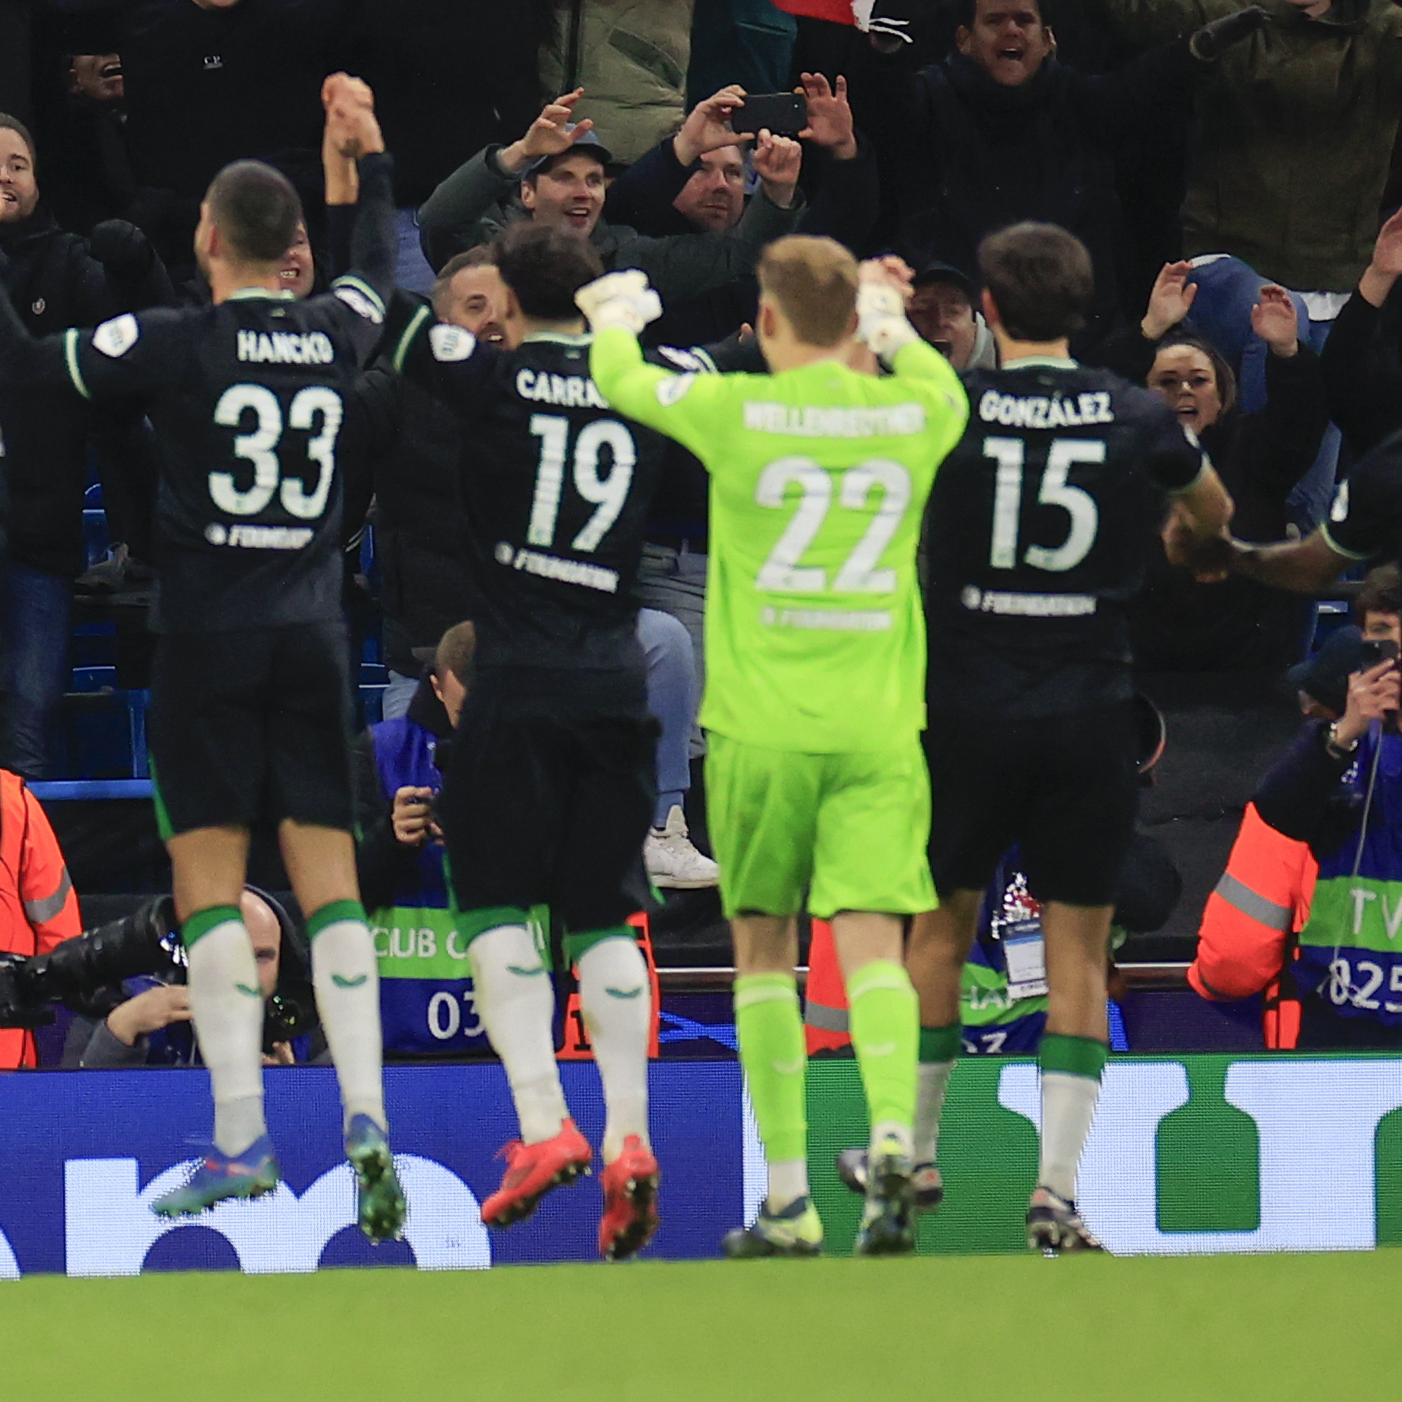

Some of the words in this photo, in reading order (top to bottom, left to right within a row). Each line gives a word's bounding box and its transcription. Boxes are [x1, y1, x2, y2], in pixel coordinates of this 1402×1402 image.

[236, 329, 335, 365] HANCKO
[208, 382, 344, 520] 33
[527, 412, 638, 554] 19
[982, 436, 1108, 572] 15
[754, 454, 912, 592] 22
[1349, 887, 1402, 940] TV
